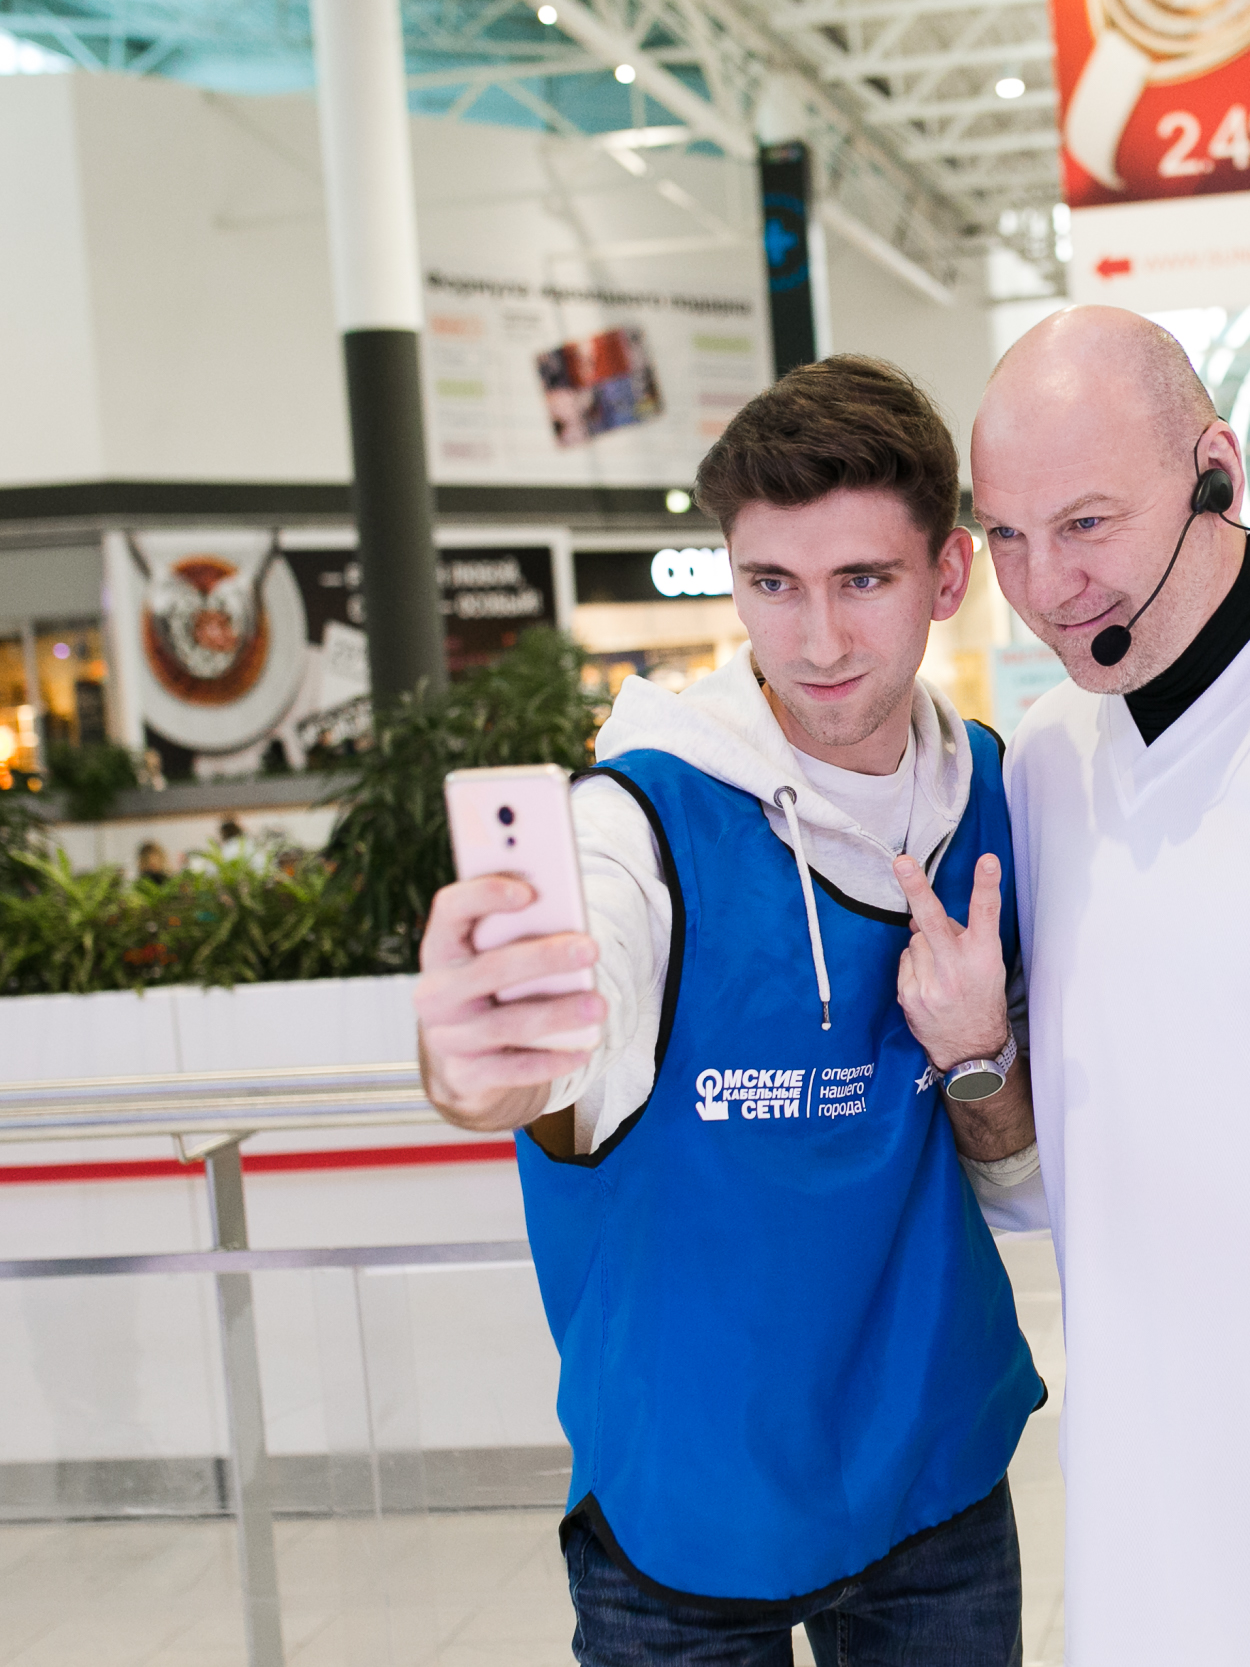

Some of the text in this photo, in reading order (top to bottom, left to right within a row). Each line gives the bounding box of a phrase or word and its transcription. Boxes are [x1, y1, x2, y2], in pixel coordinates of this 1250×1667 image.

[695, 1068, 806, 1092] ОМСКИЕ
[722, 1082, 865, 1101] КАБЕЛЬНЫЕ нашего
[741, 1096, 867, 1120] СЕТИ города!
